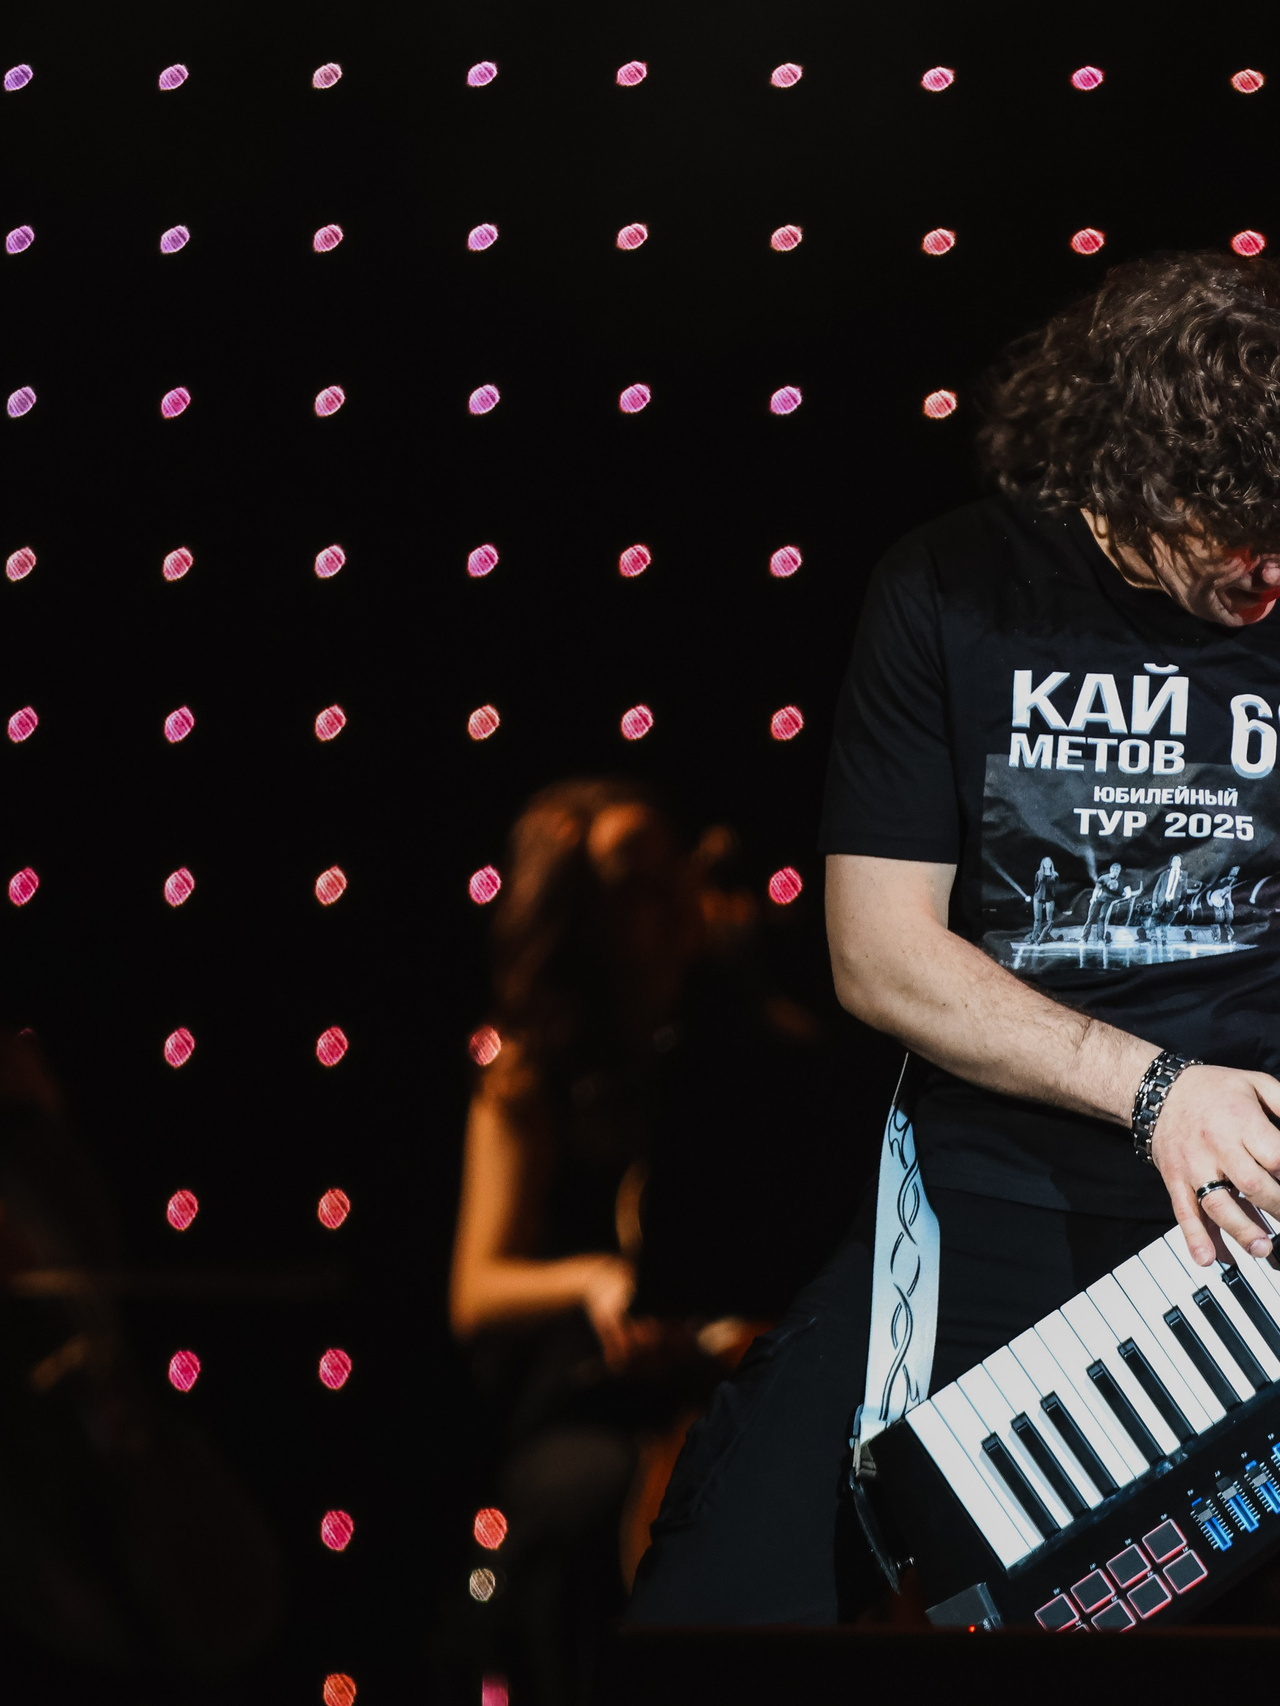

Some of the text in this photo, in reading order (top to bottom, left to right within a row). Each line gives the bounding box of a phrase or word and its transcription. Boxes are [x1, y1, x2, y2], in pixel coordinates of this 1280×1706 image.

[1011, 663, 1190, 736] КАЙ
[1008, 732, 1186, 776] МЕТОВ
[1093, 785, 1239, 808] ЮБИЛЕЙНЫЙ
[1073, 808, 1255, 841] ТУР 2025
